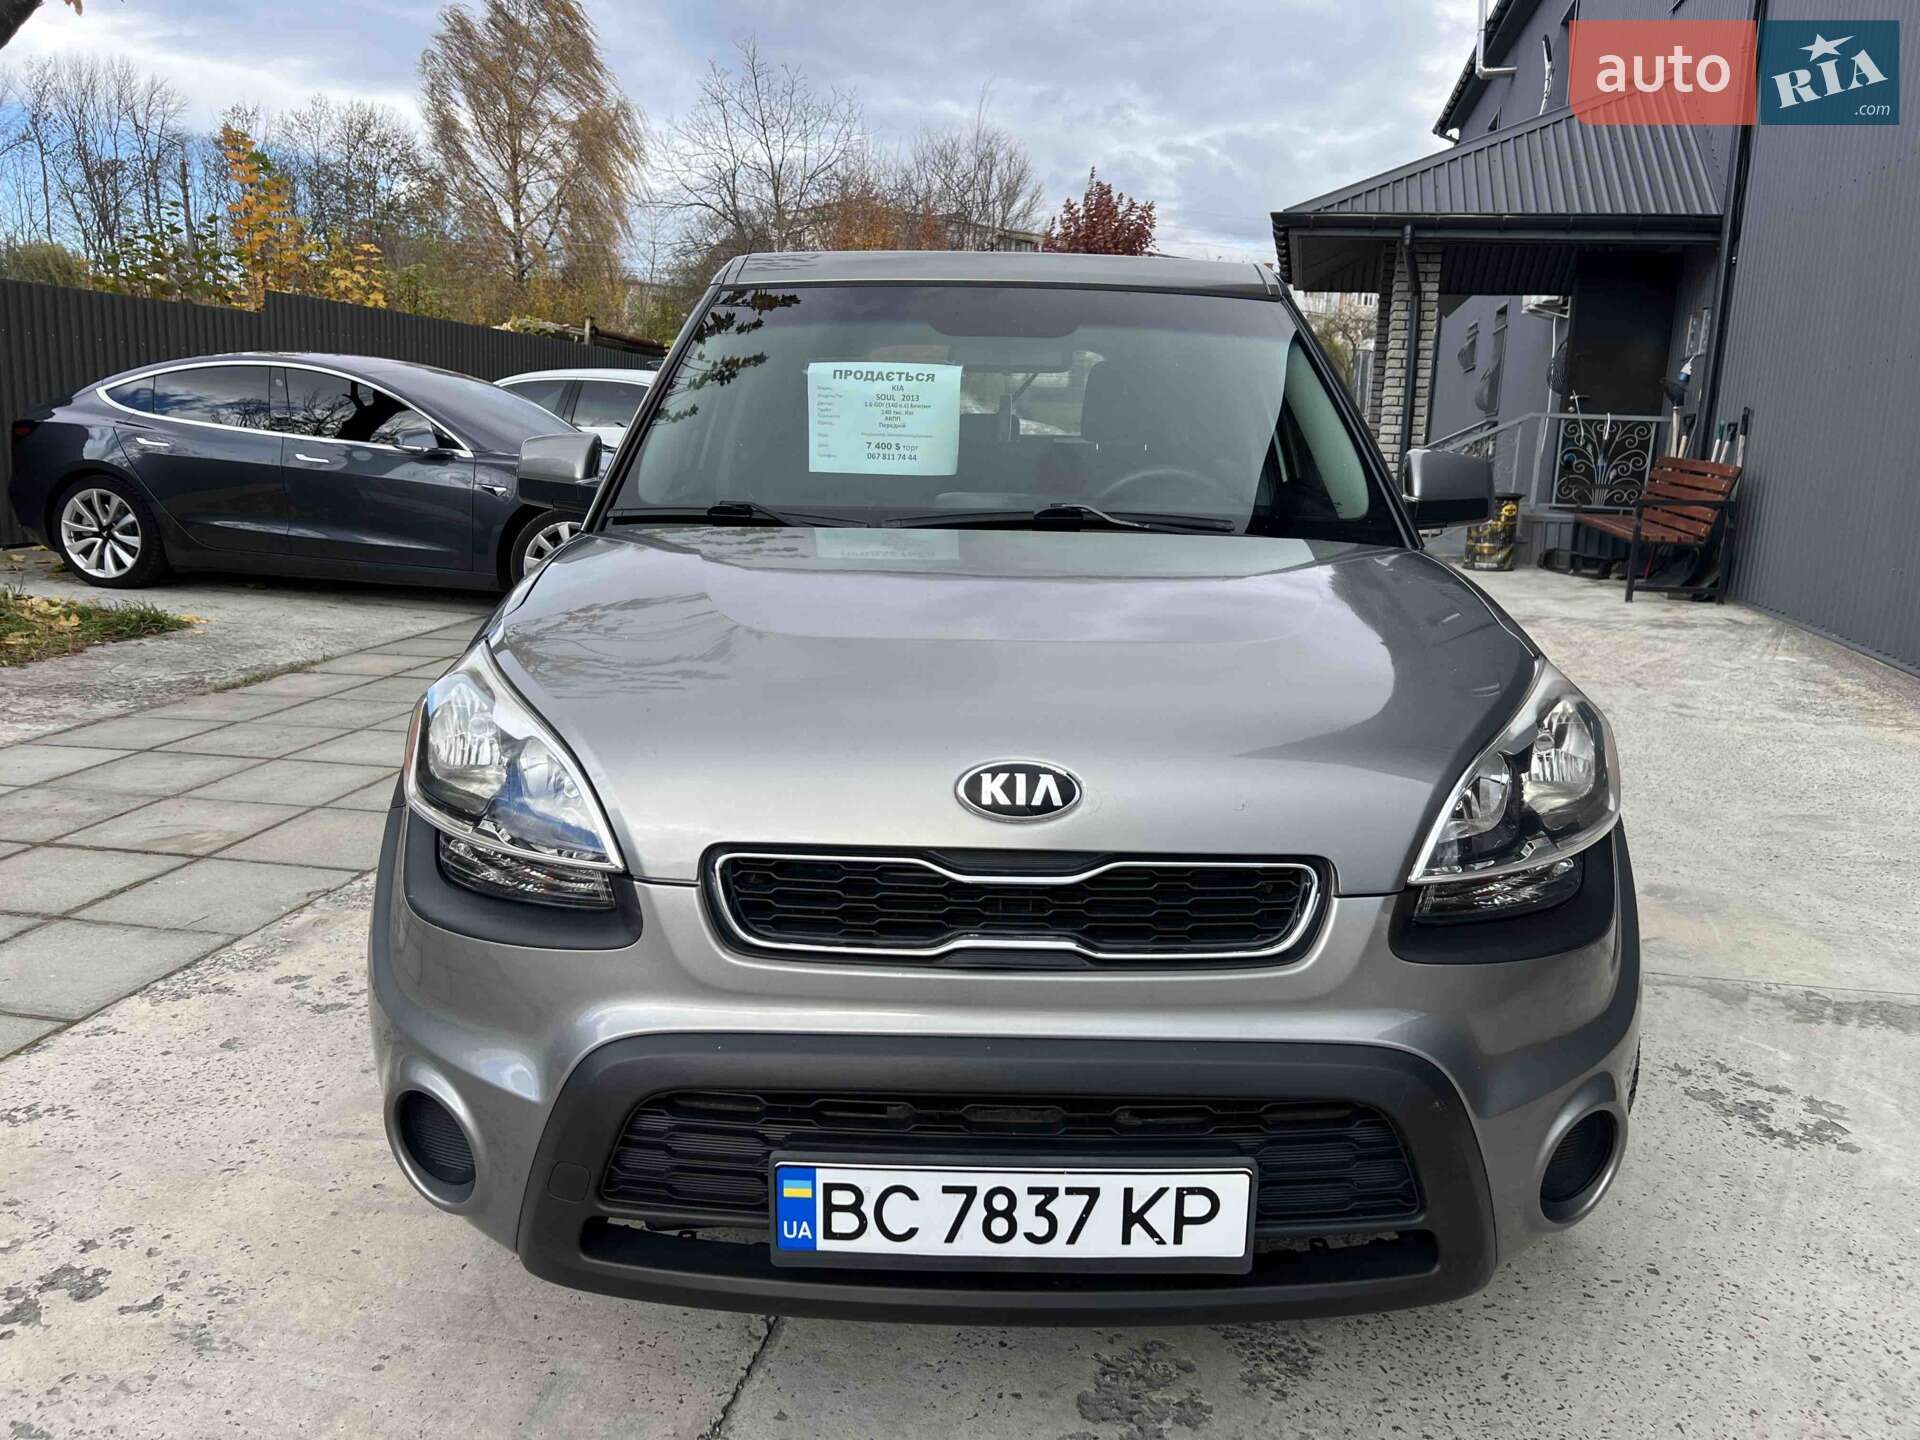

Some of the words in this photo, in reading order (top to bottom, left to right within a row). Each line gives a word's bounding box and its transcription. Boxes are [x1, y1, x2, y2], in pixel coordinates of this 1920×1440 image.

[832, 369, 936, 383] ПРОДАЄТЬСЯ
[875, 393, 896, 402] SOUL
[901, 394, 920, 402] 2013
[866, 441, 872, 450] 7
[875, 442, 893, 450] 400
[867, 452, 881, 460] 067
[980, 772, 1063, 806] KIA
[822, 1182, 920, 1243] BC
[941, 1185, 1101, 1246] 7837
[1121, 1186, 1222, 1246] KP
[783, 1220, 813, 1240] UA
